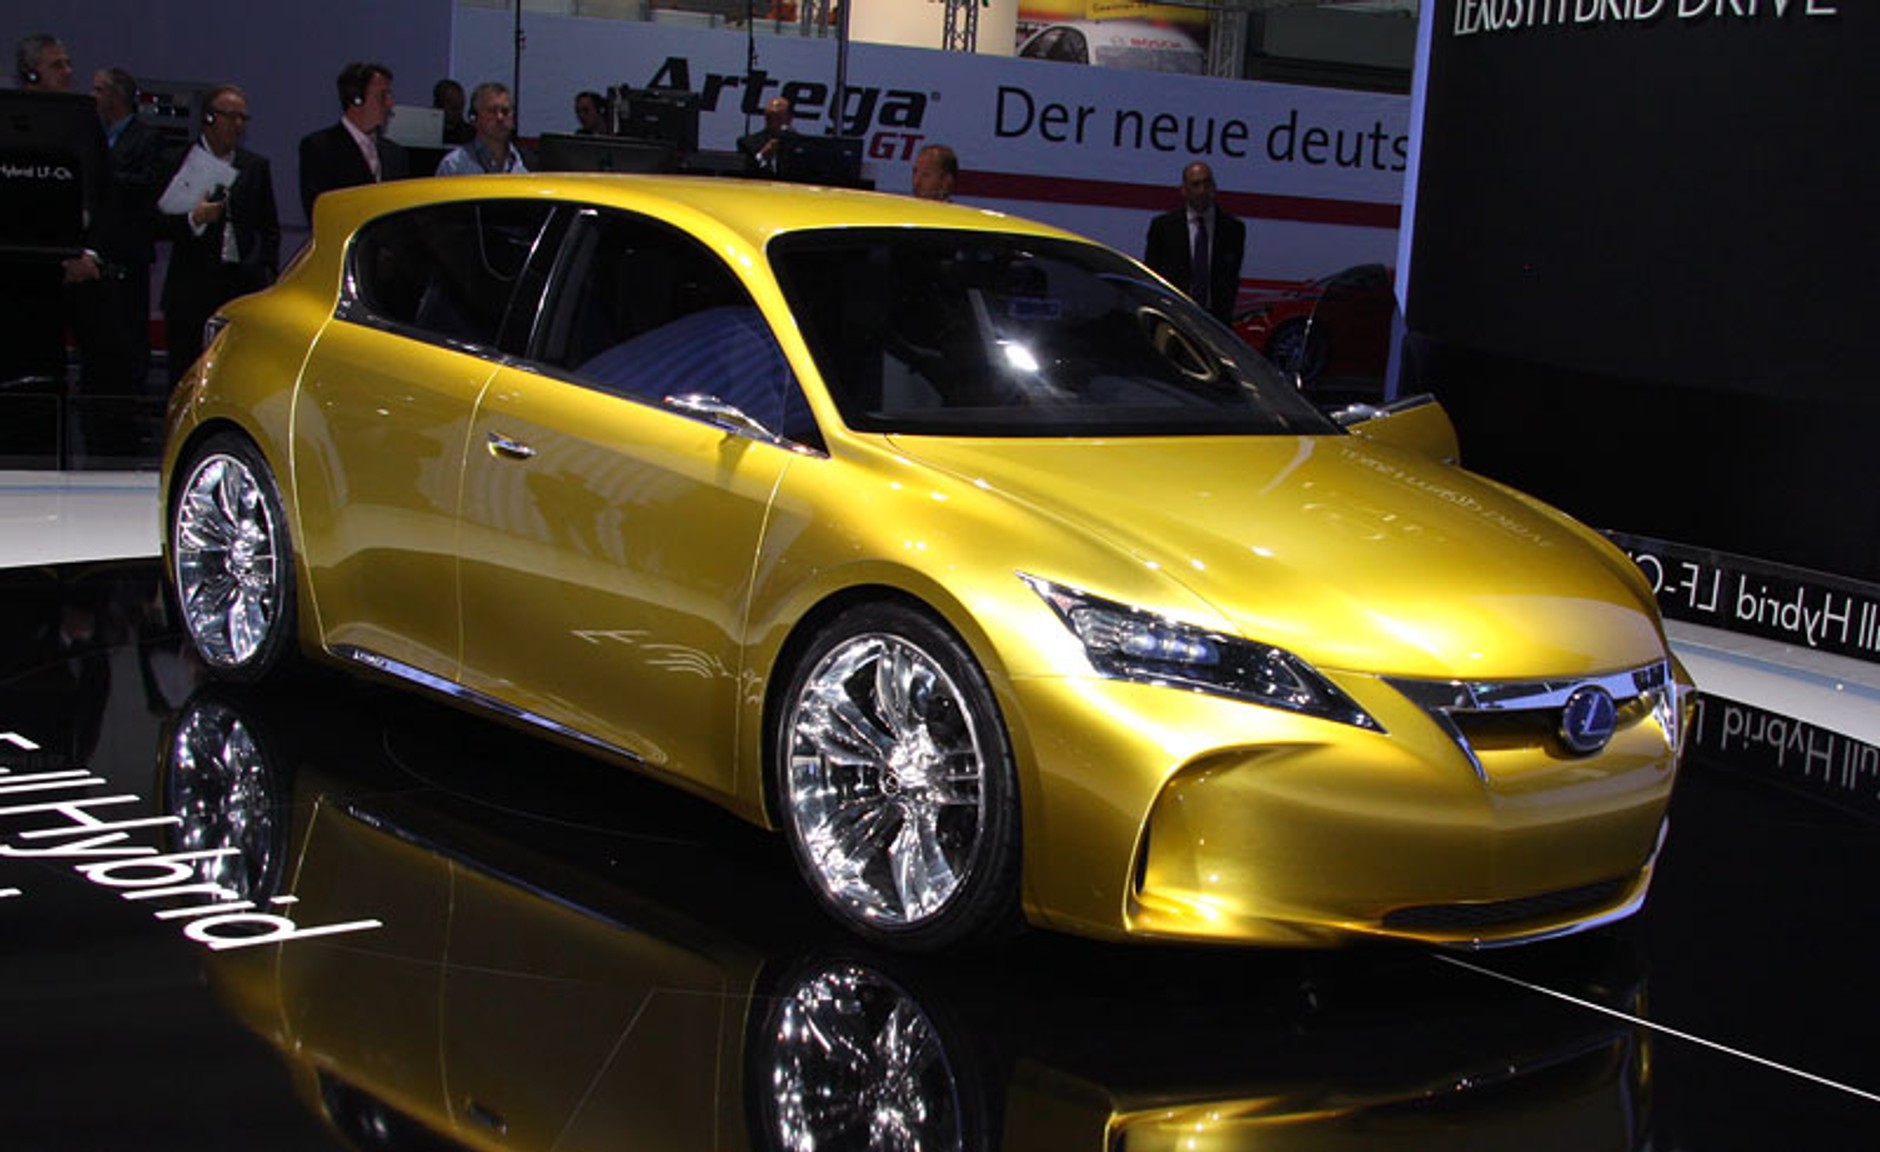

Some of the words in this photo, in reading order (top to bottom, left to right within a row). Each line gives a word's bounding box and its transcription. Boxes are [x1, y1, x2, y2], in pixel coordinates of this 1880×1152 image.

[646, 56, 931, 136] Artega
[993, 85, 1096, 145] Der
[1112, 108, 1249, 159] neue
[1265, 109, 1410, 172] deuts
[867, 131, 926, 161] GT
[1720, 706, 1834, 782] Hybrid
[1841, 739, 1880, 791] ull
[0, 794, 383, 950] Hybrid
